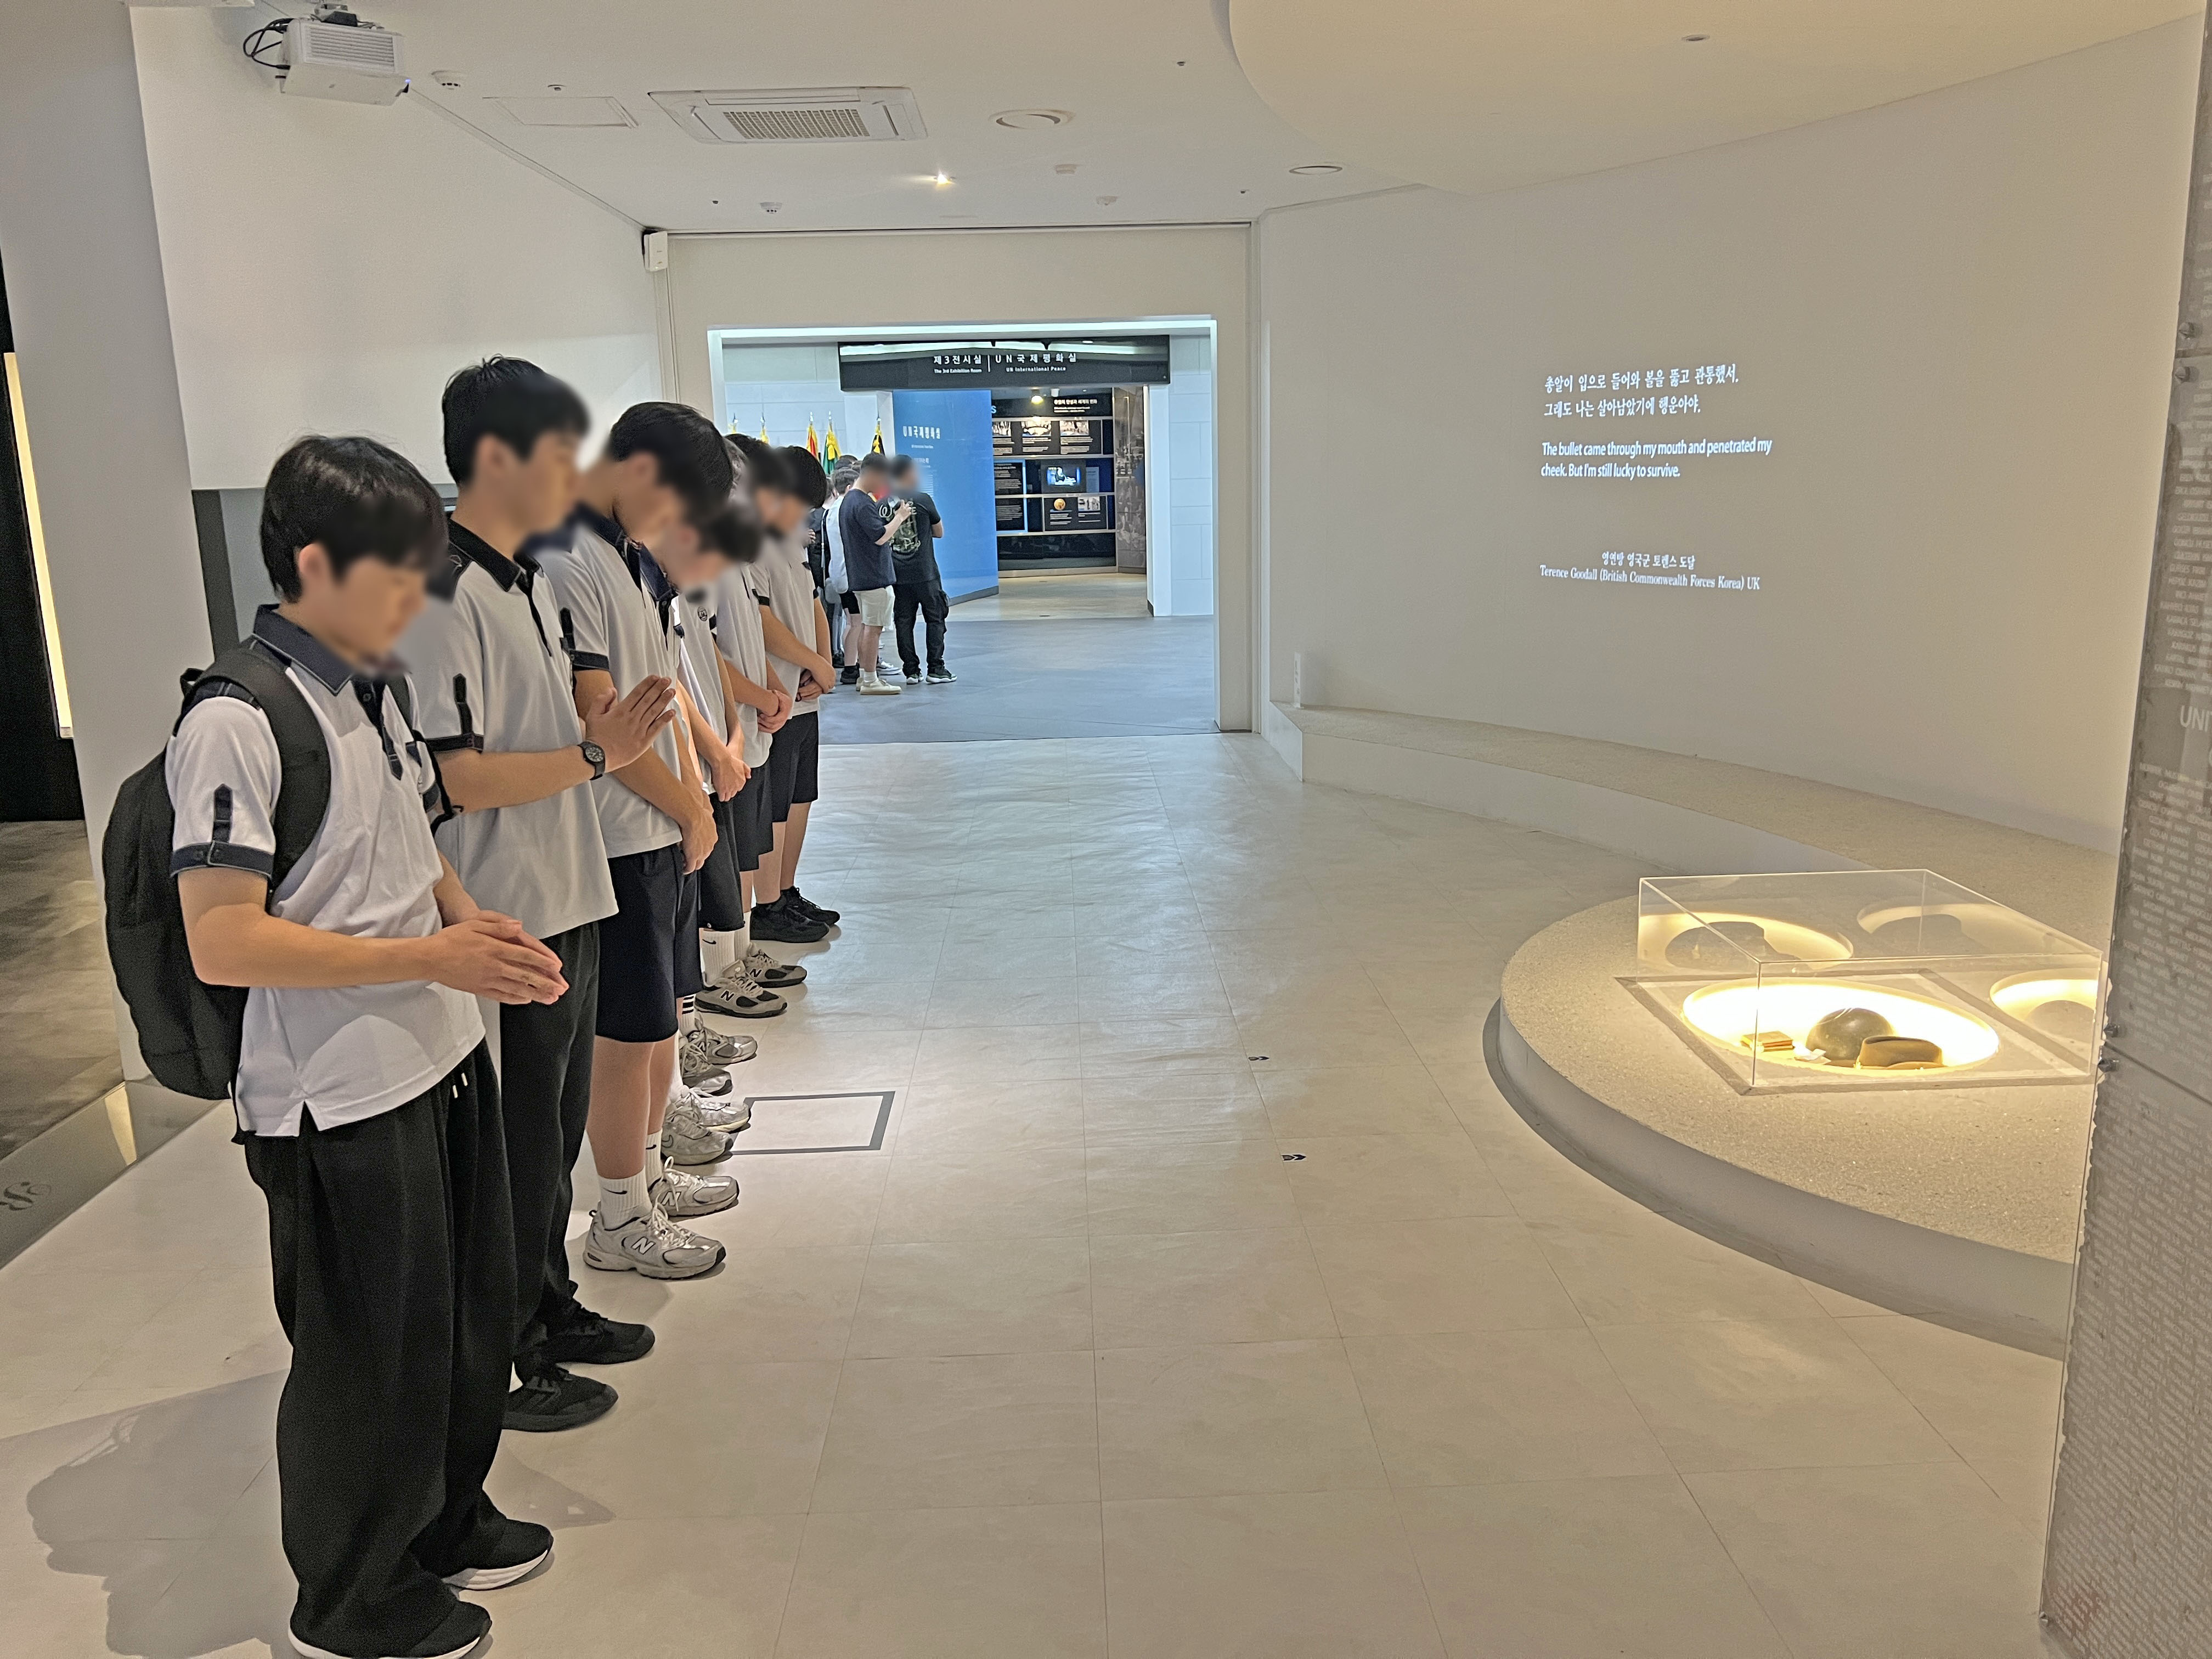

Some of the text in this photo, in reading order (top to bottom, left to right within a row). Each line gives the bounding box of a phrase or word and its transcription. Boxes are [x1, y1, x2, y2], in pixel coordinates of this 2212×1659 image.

[934, 355, 981, 365] 제3전시실
[995, 353, 1076, 363] UN국제평화실
[1544, 375, 1573, 393] 총알이
[1578, 374, 1606, 392] 입으로
[1611, 371, 1640, 390] 들어와
[1645, 369, 1665, 388] 볼을
[1669, 369, 1690, 387] 뚫고
[1544, 401, 1572, 418] 그래도
[1576, 400, 1595, 417] 나는
[1597, 397, 1655, 417] 살아남았기에
[1542, 437, 1773, 459] The bullet came through my mouth and penetrated my
[1541, 462, 1680, 481] cheek. But I'm still lucky to survive.
[1601, 551, 1624, 566] 영연방
[1627, 552, 1650, 568] 영국군
[1539, 565, 1760, 591] Terence Goodall (British Commonwealth Forces Korea) UK
[720, 990, 735, 1002] N
[631, 1235, 656, 1255] N
